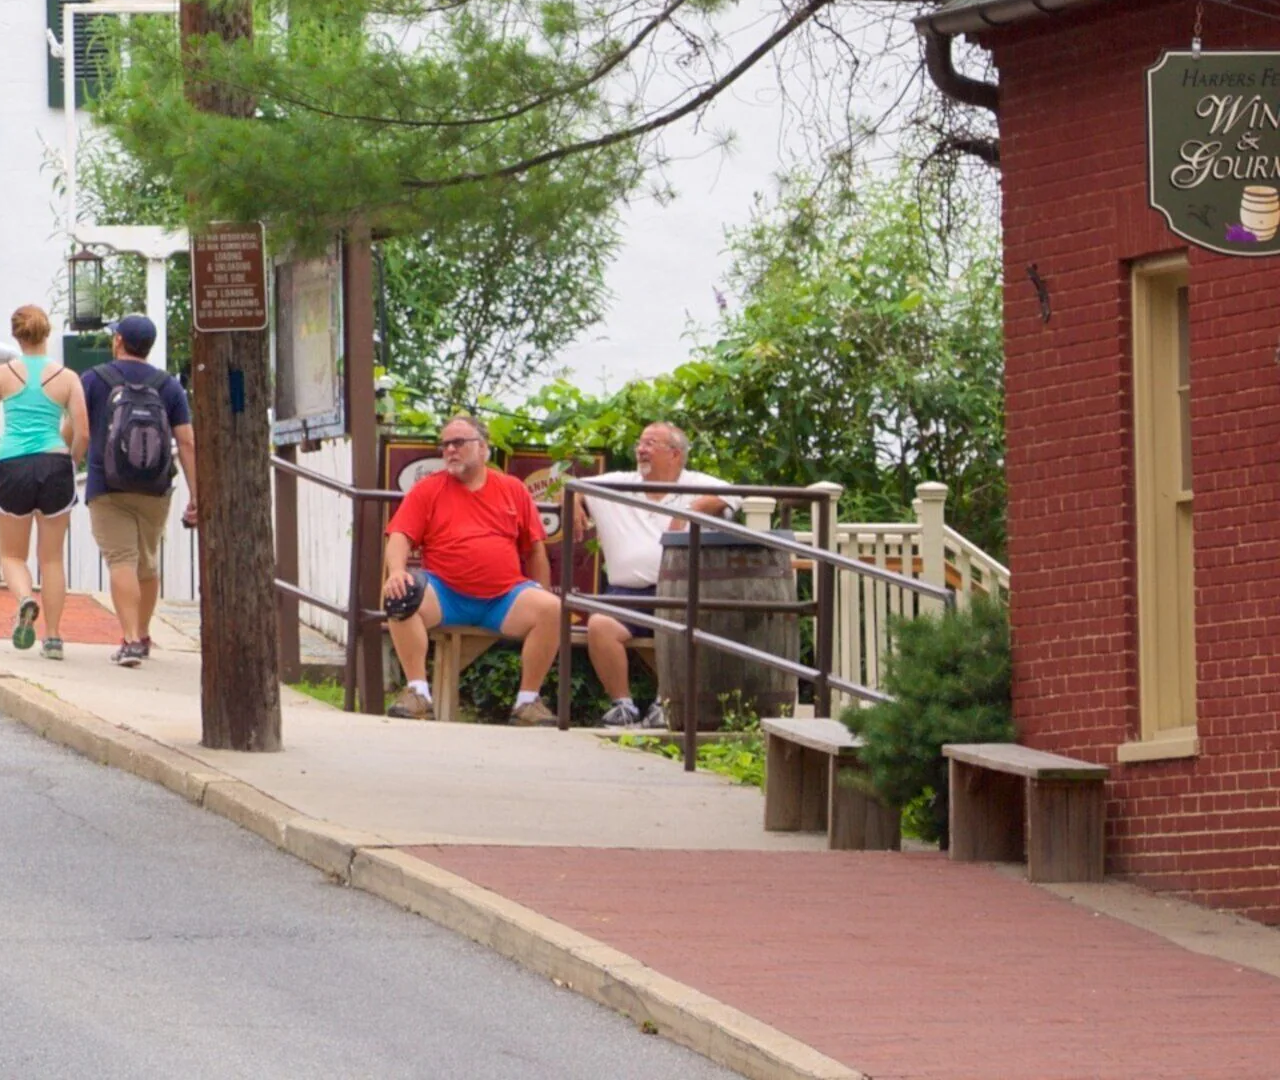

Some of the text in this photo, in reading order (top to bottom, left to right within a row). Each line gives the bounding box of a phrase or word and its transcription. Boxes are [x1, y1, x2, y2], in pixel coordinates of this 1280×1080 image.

[1182, 69, 1256, 88] HARPERS
[1196, 94, 1280, 134] WIN
[1237, 131, 1262, 151] &
